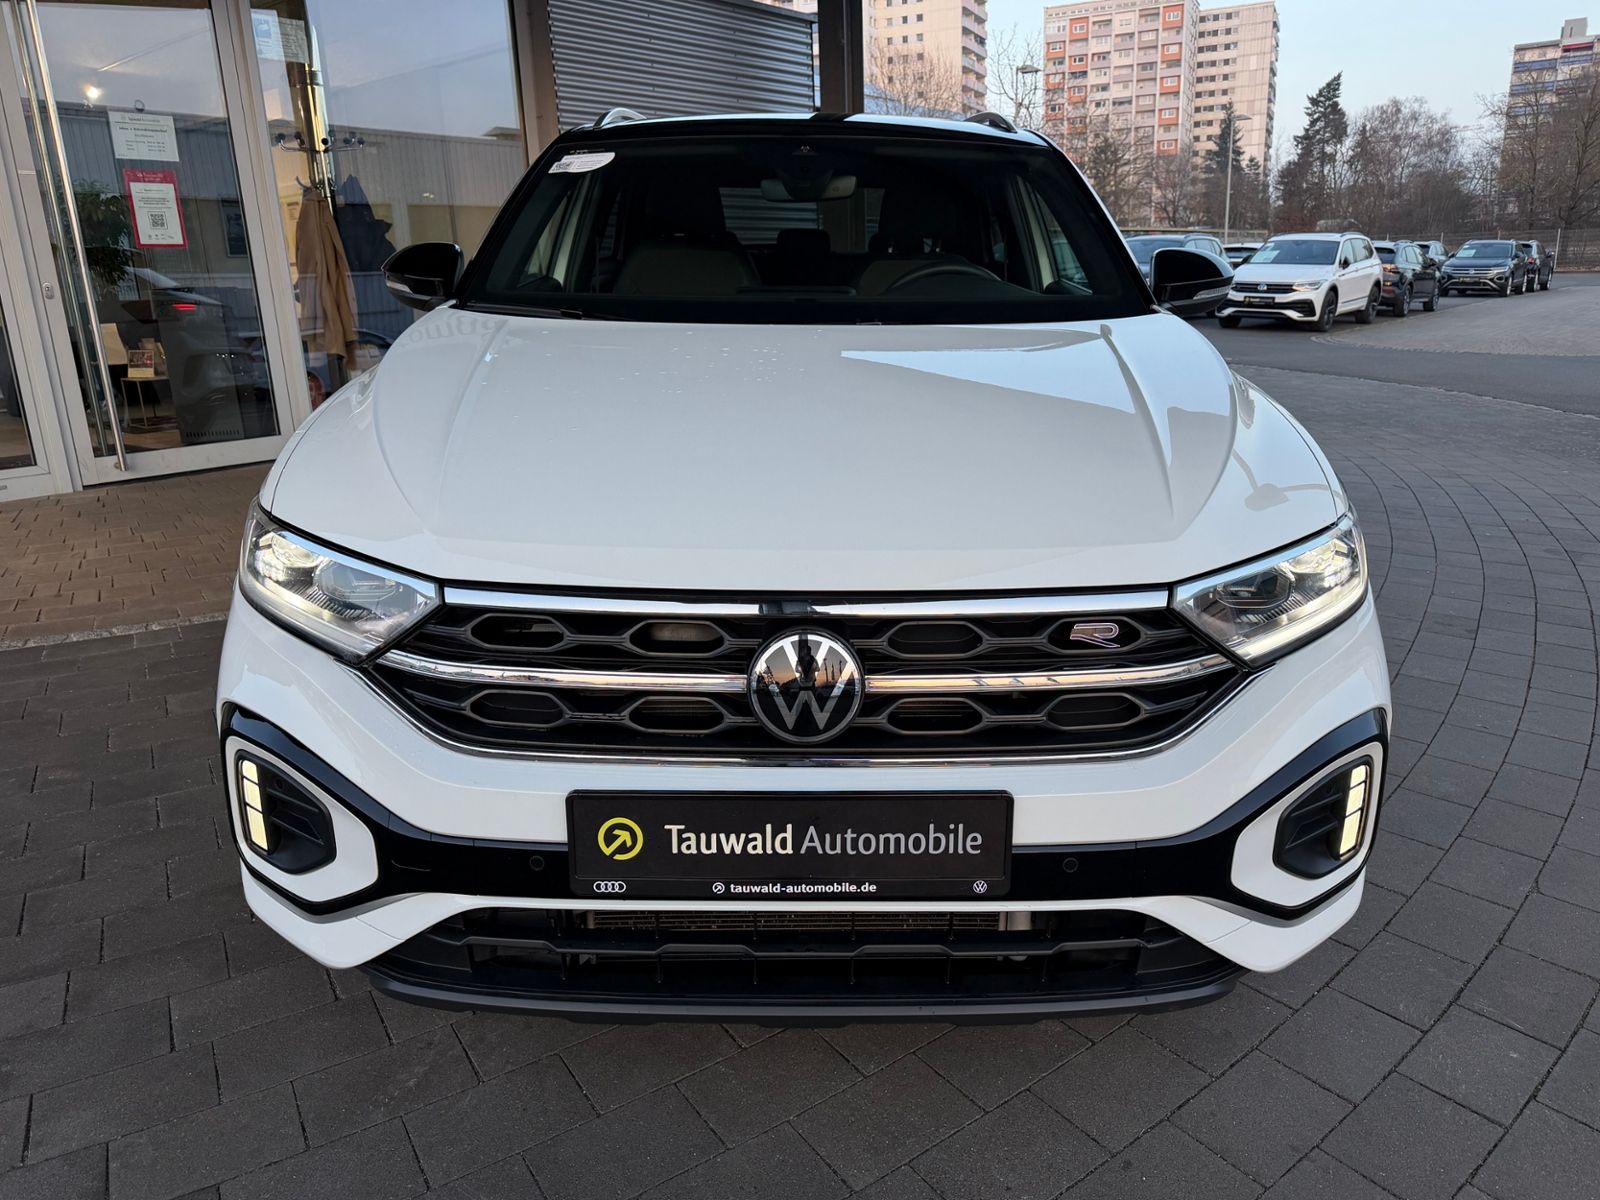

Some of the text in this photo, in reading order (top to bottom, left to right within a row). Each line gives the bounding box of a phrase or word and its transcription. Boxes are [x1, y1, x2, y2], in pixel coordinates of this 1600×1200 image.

[664, 823, 983, 855] Tauwald Automobile
[729, 881, 877, 894] tauwald-automobile.de
